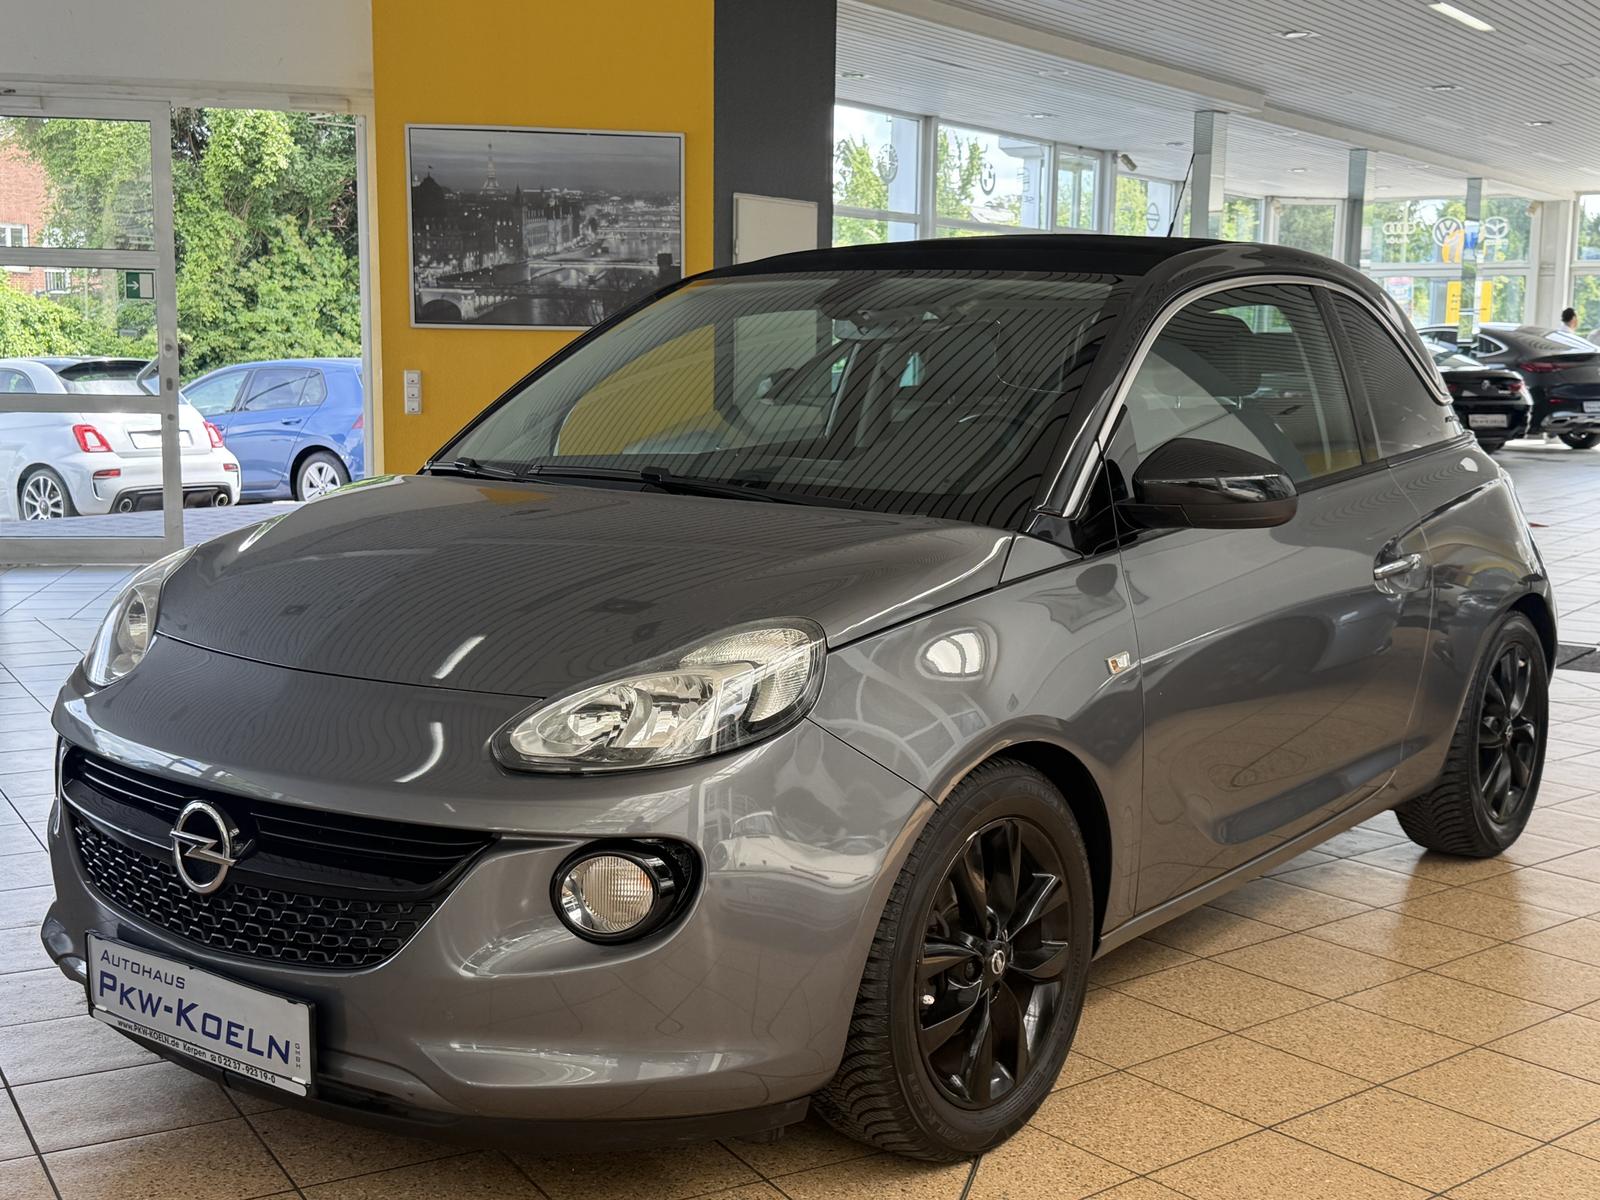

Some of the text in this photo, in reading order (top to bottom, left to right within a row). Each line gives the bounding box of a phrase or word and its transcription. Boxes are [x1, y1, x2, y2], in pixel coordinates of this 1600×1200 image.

[100, 949, 186, 990] AUTOHAUS
[99, 970, 290, 1065] PKW-KOELN
[182, 1042, 207, 1059] Kerpen
